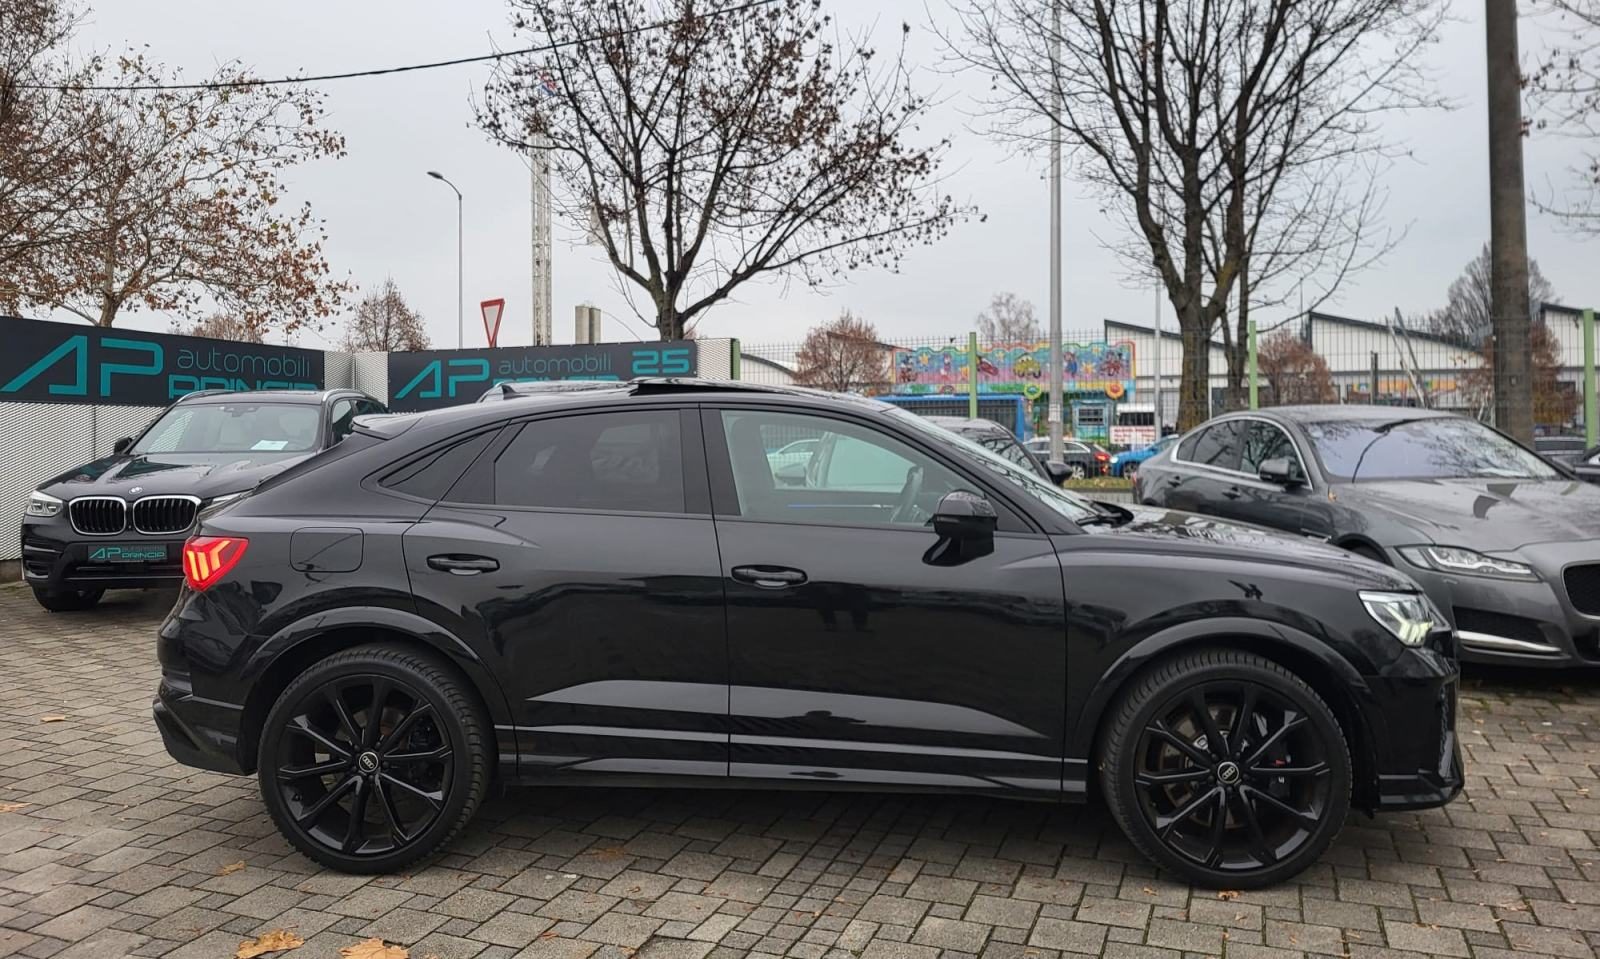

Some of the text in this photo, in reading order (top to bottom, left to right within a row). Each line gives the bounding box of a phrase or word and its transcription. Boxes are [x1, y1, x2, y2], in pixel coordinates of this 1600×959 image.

[0, 335, 164, 397] AP
[177, 348, 311, 378] automobili
[498, 352, 612, 375] automobili
[632, 349, 689, 373] 25
[394, 358, 490, 398] AP
[90, 548, 121, 558] AP
